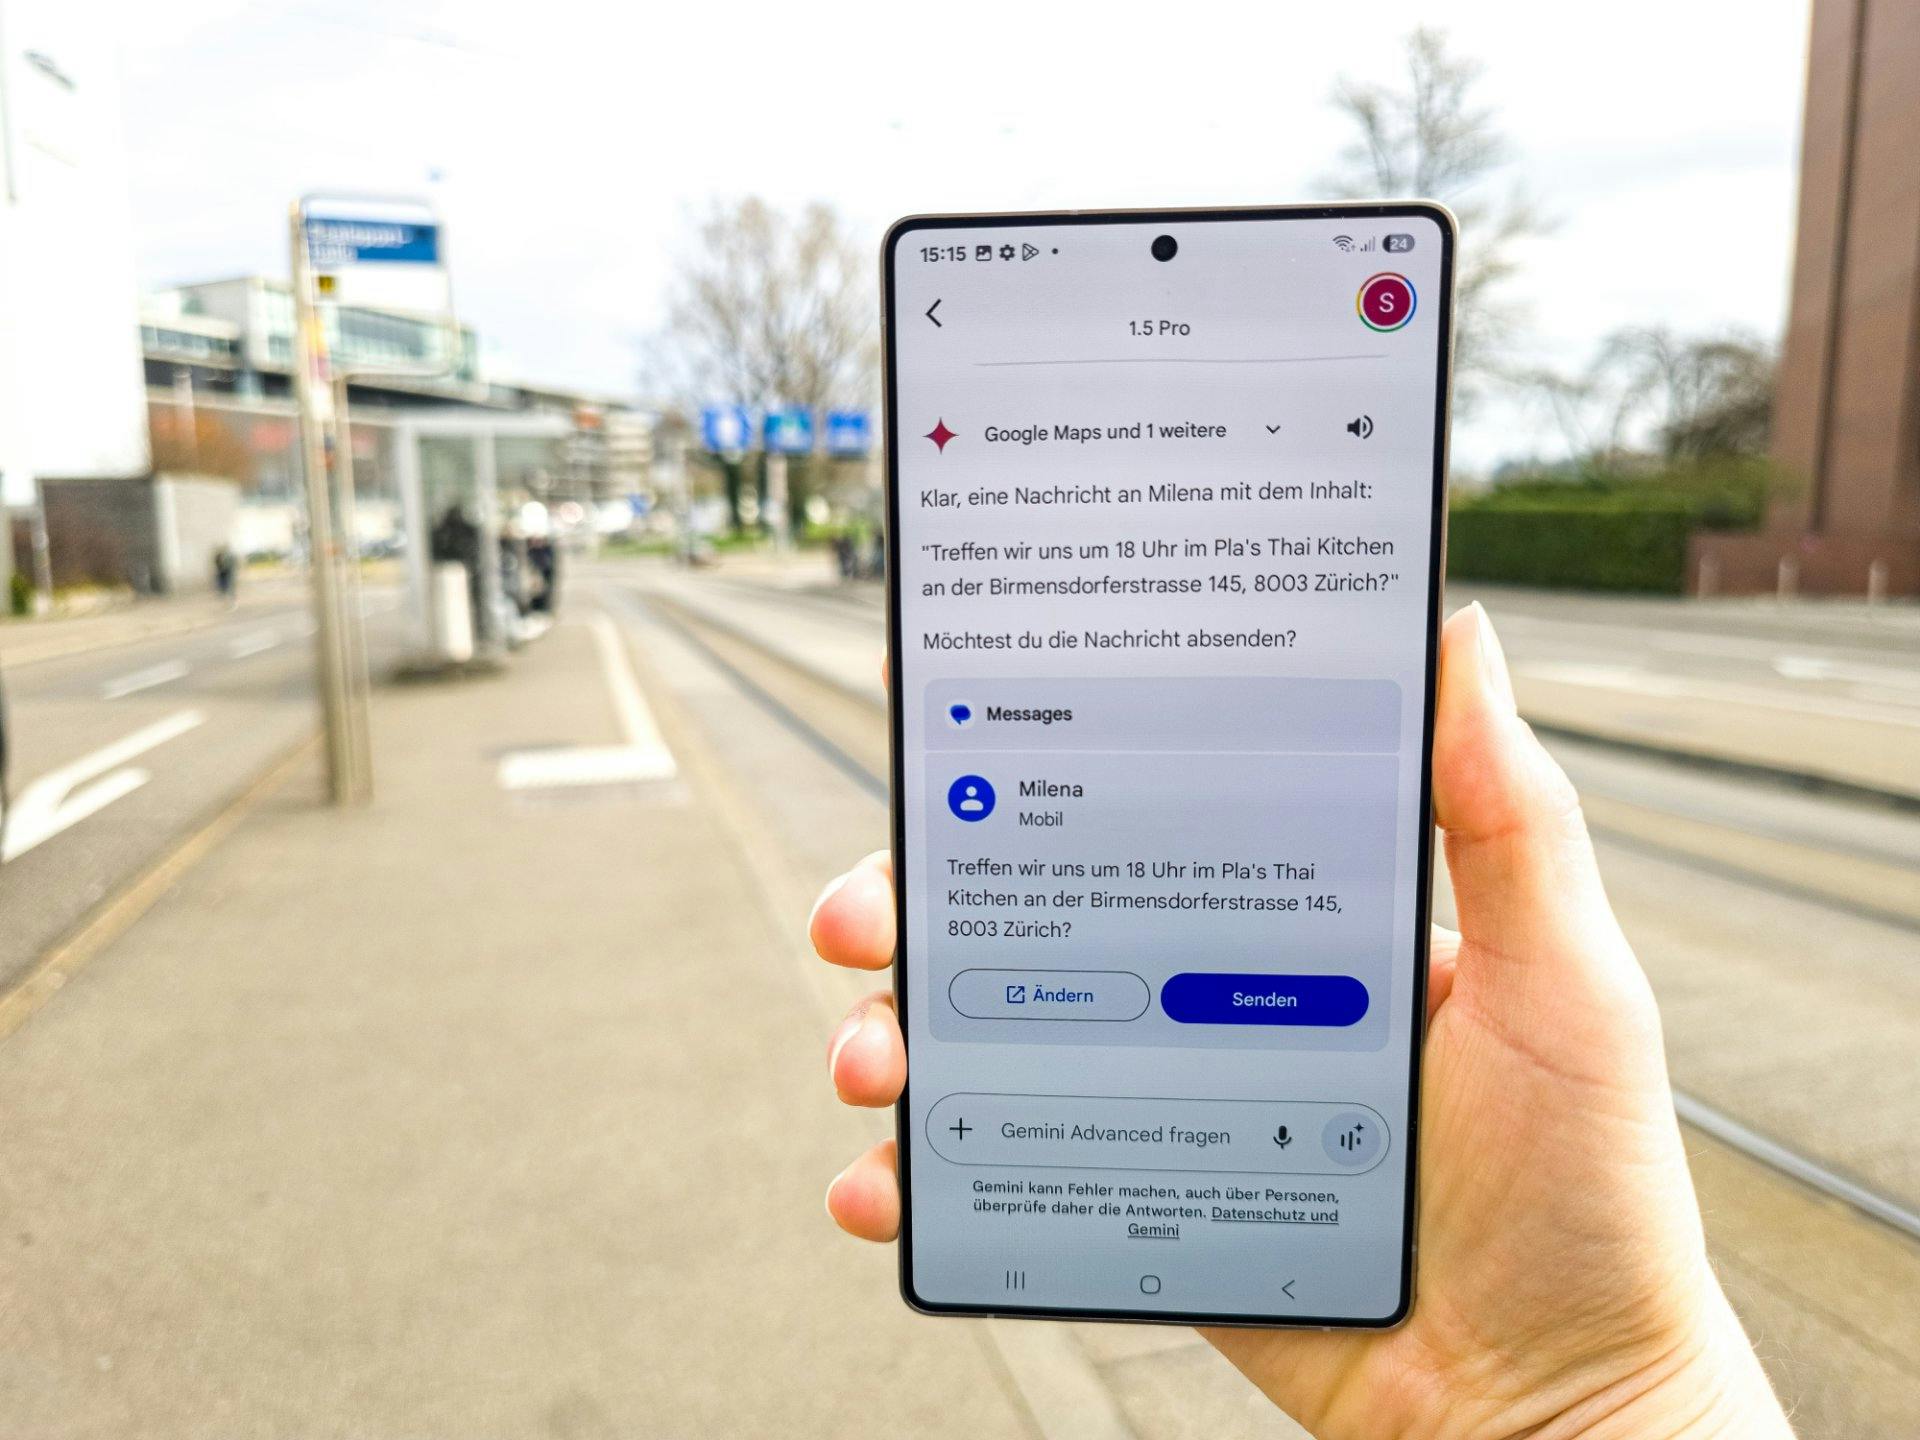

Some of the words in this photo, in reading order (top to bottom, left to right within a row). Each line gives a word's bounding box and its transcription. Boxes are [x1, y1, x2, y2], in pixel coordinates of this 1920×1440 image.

[919, 245, 967, 263] 15:15
[1390, 238, 1408, 250] 24
[1379, 292, 1395, 313] S
[1128, 319, 1154, 337] 1.5
[1158, 319, 1191, 337] Pro
[984, 424, 1050, 446] Google
[1053, 424, 1103, 445] Maps
[1106, 421, 1142, 440] und
[1145, 422, 1154, 439] 1
[1158, 420, 1228, 439] weitere
[920, 488, 962, 510] Klar,
[967, 486, 1009, 506] eine
[1014, 484, 1113, 505] Nachricht
[1117, 488, 1143, 504] an
[1148, 481, 1214, 503] Milena
[1220, 481, 1253, 502] mit
[1257, 480, 1304, 501] dem
[1310, 479, 1373, 500] Inhalt:
[921, 541, 999, 562] "Treffen
[1003, 541, 1033, 561] wir
[1038, 544, 1074, 561] uns
[1078, 544, 1110, 560] um
[1114, 540, 1137, 559] 18
[1142, 538, 1179, 559] Uhr
[1184, 538, 1208, 558] im
[1214, 537, 1262, 557] Pla's
[1266, 536, 1311, 557] Thai
[1317, 535, 1394, 556] Kitchen
[921, 582, 946, 597] an
[950, 576, 984, 597] der
[989, 574, 1203, 596] Birmensdorferstrasse
[1208, 574, 1247, 595] 145,
[1253, 573, 1309, 593] 8003
[1313, 571, 1400, 593] Zürich?"
[922, 631, 1013, 651] Möchtest
[1017, 630, 1043, 650] du
[1047, 630, 1079, 649] die
[1083, 628, 1182, 649] Nachricht
[1186, 627, 1297, 648] absenden?
[986, 705, 1074, 726] Messages
[1018, 779, 1084, 798] Milena
[1018, 810, 1064, 828] Mobil
[946, 857, 1013, 877] Treffen
[1016, 858, 1047, 877] wir
[1051, 863, 1086, 878] uns
[1090, 864, 1121, 879] um
[1125, 861, 1146, 879] 18
[1151, 860, 1188, 879] Uhr
[1192, 860, 1216, 880] im
[1221, 861, 1268, 881] Pla's
[1272, 862, 1316, 881] Thai
[947, 888, 1019, 907] Kitchen
[1023, 894, 1047, 908] an
[1051, 889, 1085, 909] der
[1090, 890, 1299, 912] Birmensdorferstrasse
[1304, 894, 1343, 915] 145,
[947, 919, 1000, 937] 8003
[1003, 919, 1072, 938] Zürich?
[1032, 983, 1095, 1004] Ändern
[1232, 992, 1298, 1008] Senden
[1000, 1122, 1065, 1140] Gemini
[1070, 1123, 1163, 1144] Advanced
[1168, 1125, 1231, 1149] fragen
[972, 1179, 1024, 1196] Gemini
[1028, 1180, 1064, 1197] kann
[1067, 1181, 1115, 1198] Fehler
[1118, 1184, 1182, 1202] machen,
[1183, 1185, 1222, 1201] auch
[1225, 1186, 1261, 1202] über
[1264, 1188, 1340, 1205] Personen,
[973, 1197, 1047, 1217] überprüfe
[1051, 1199, 1095, 1216] daher
[1098, 1201, 1122, 1217] die
[1125, 1203, 1207, 1220] Antworten.
[1210, 1206, 1306, 1221] Datenschutz
[1310, 1208, 1339, 1222] und
[1127, 1222, 1180, 1237] Gemini
